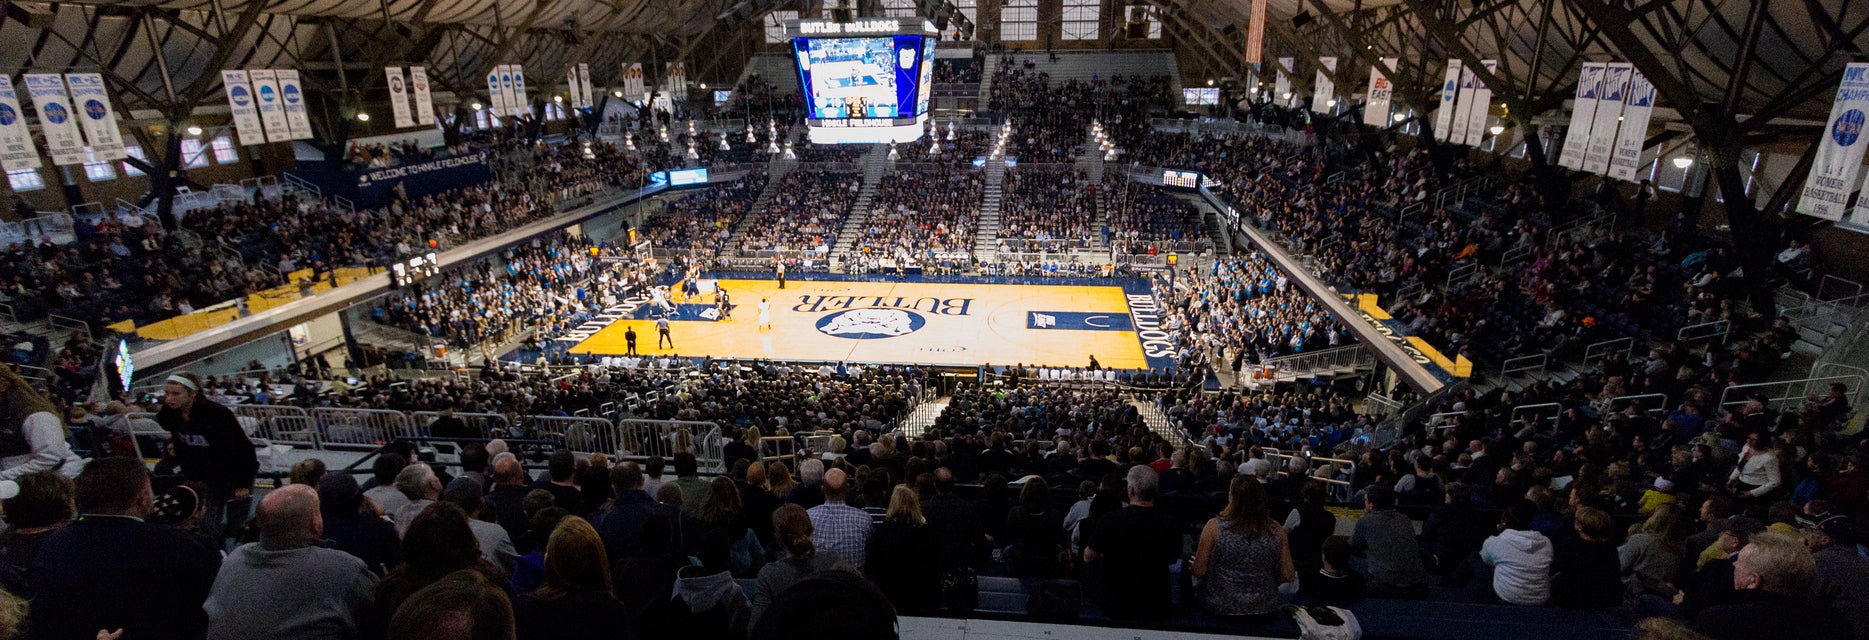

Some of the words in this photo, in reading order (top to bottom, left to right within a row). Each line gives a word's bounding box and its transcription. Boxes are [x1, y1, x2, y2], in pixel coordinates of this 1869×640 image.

[800, 21, 840, 34] BUTLER
[844, 20, 899, 33] BULLDOGS
[1374, 78, 1389, 88] BIG
[1371, 89, 1391, 100] EAST
[369, 166, 407, 181] WELCOME
[408, 163, 418, 174] TO
[418, 160, 442, 172] HINKLE
[442, 155, 479, 169] FIELDHOUSE
[1804, 187, 1846, 204] BASKETBALL
[792, 295, 976, 316] BUTLER
[1126, 294, 1177, 358] BULLDOGS
